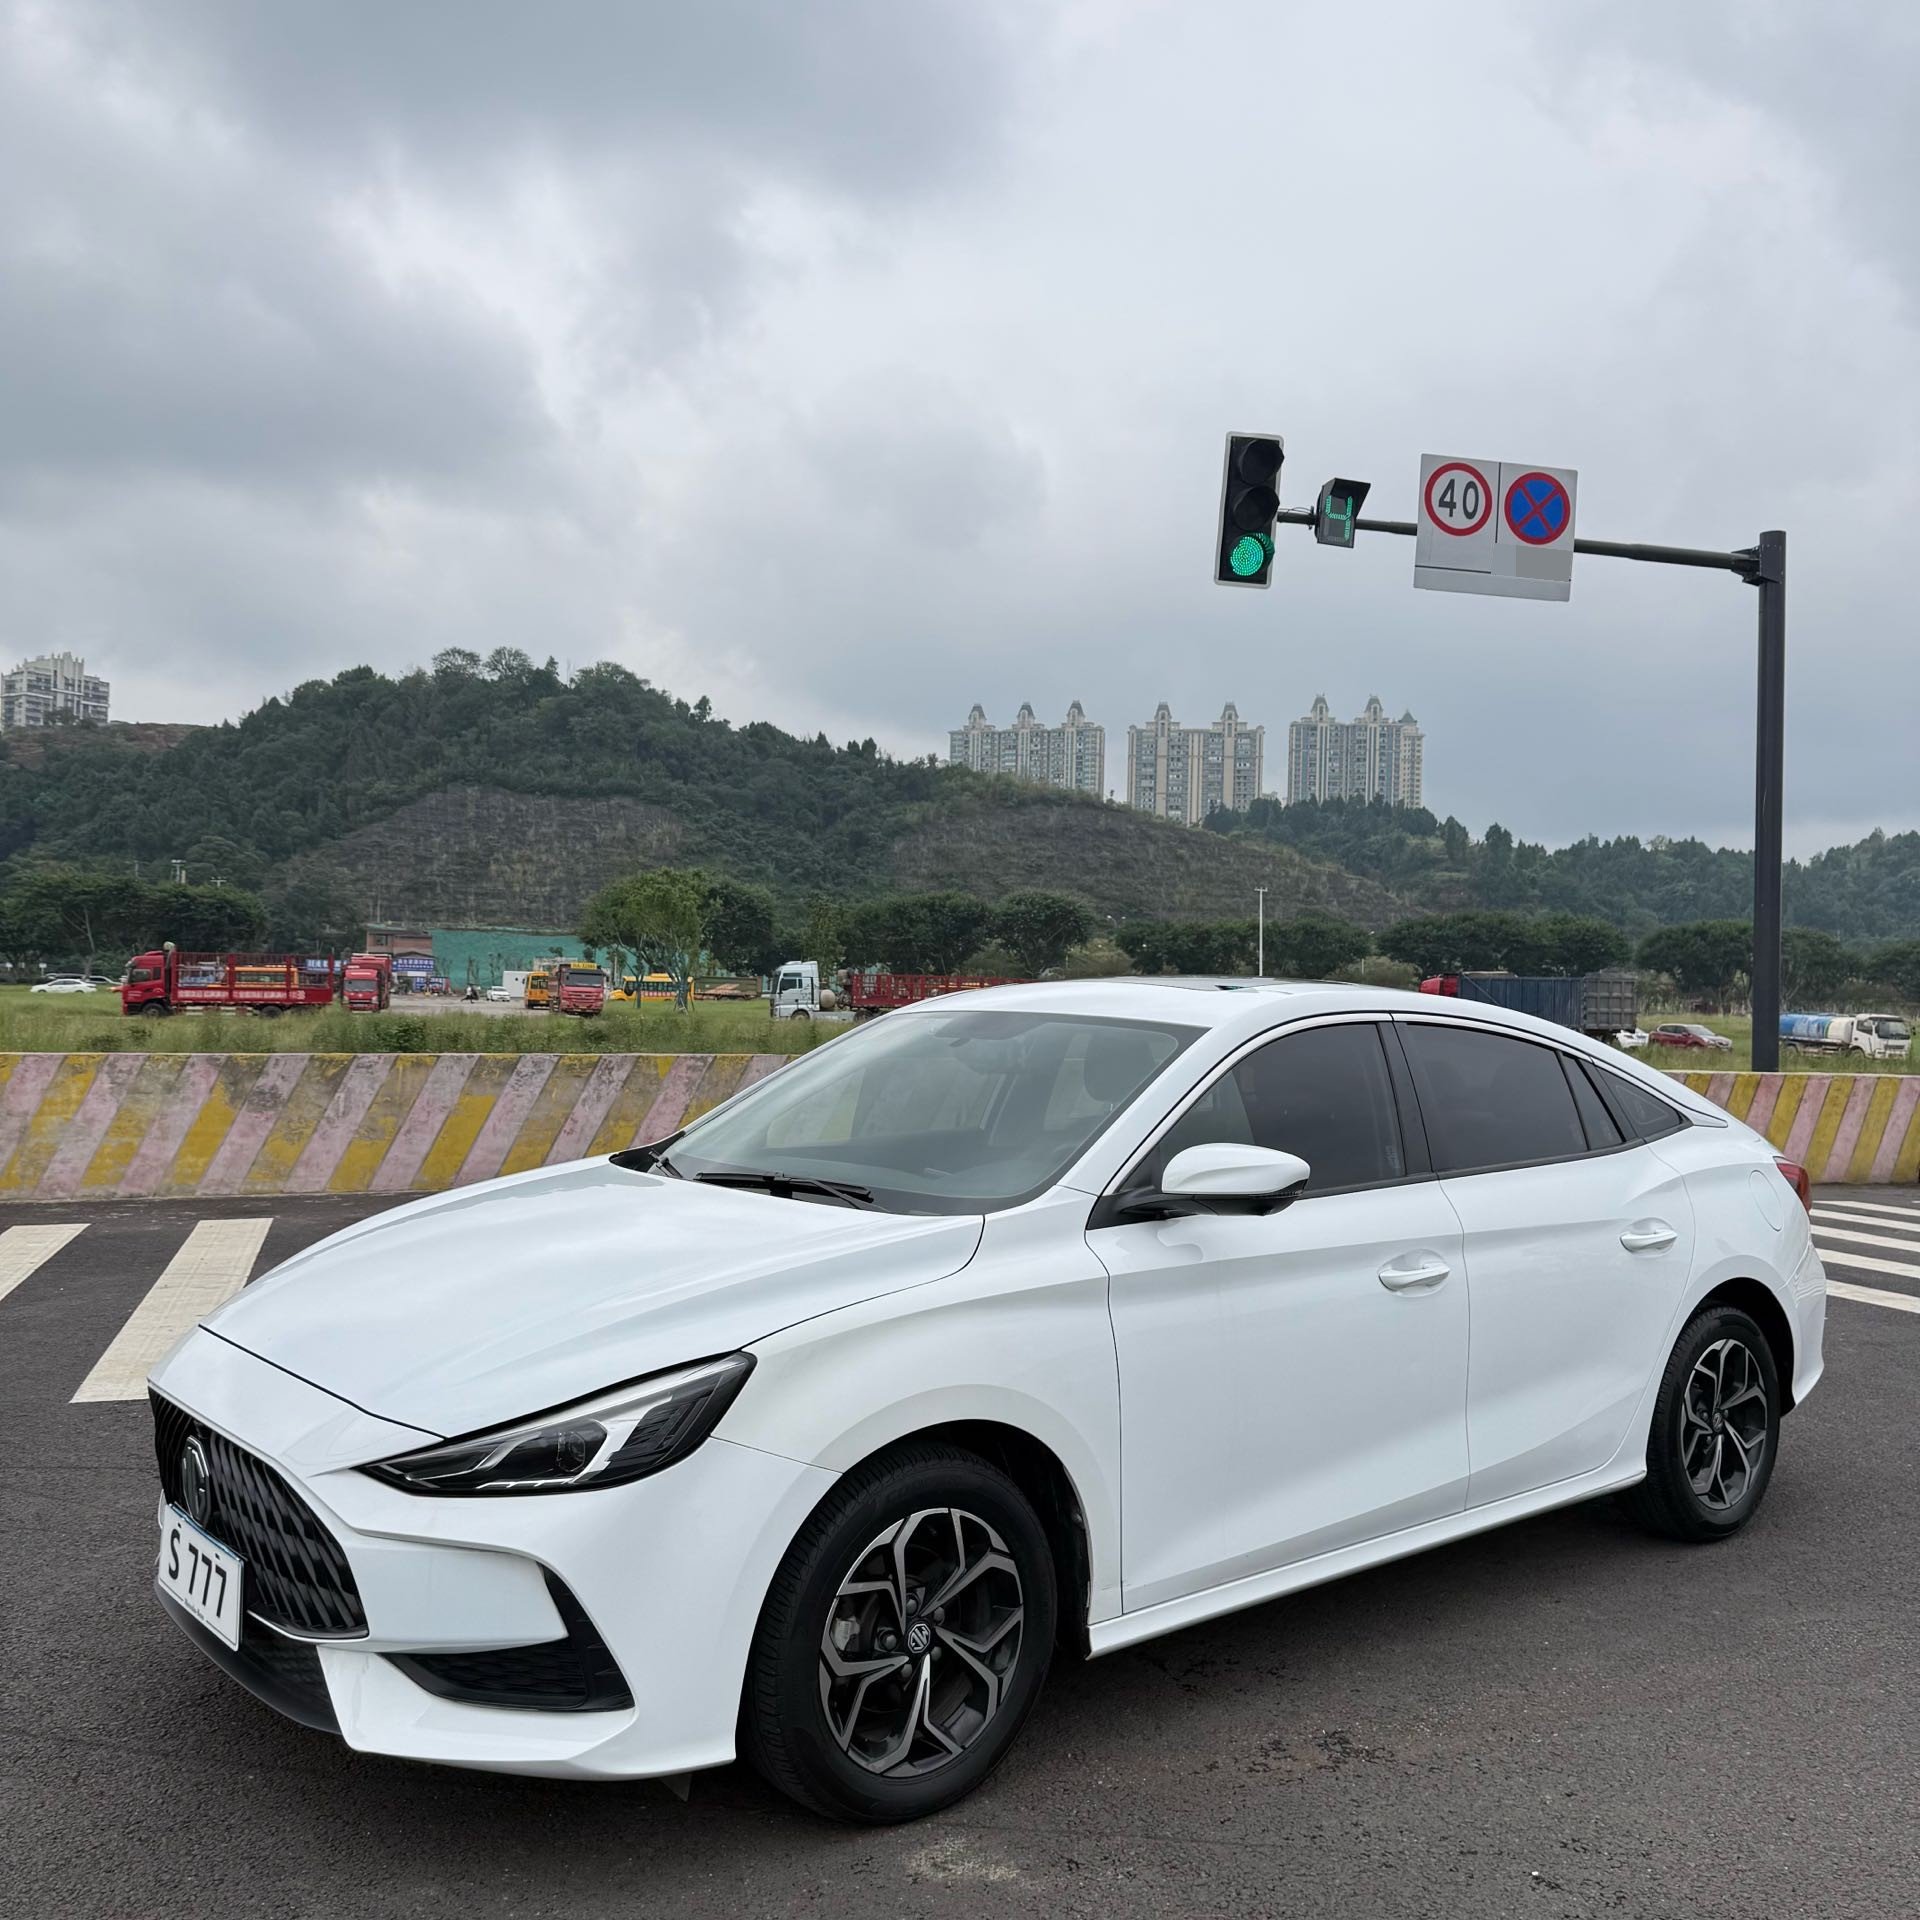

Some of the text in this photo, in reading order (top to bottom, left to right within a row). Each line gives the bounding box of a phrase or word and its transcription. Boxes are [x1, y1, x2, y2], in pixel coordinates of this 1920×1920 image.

[1325, 494, 1353, 541] 4
[1438, 478, 1480, 520] 40
[168, 1528, 227, 1618] S 777
